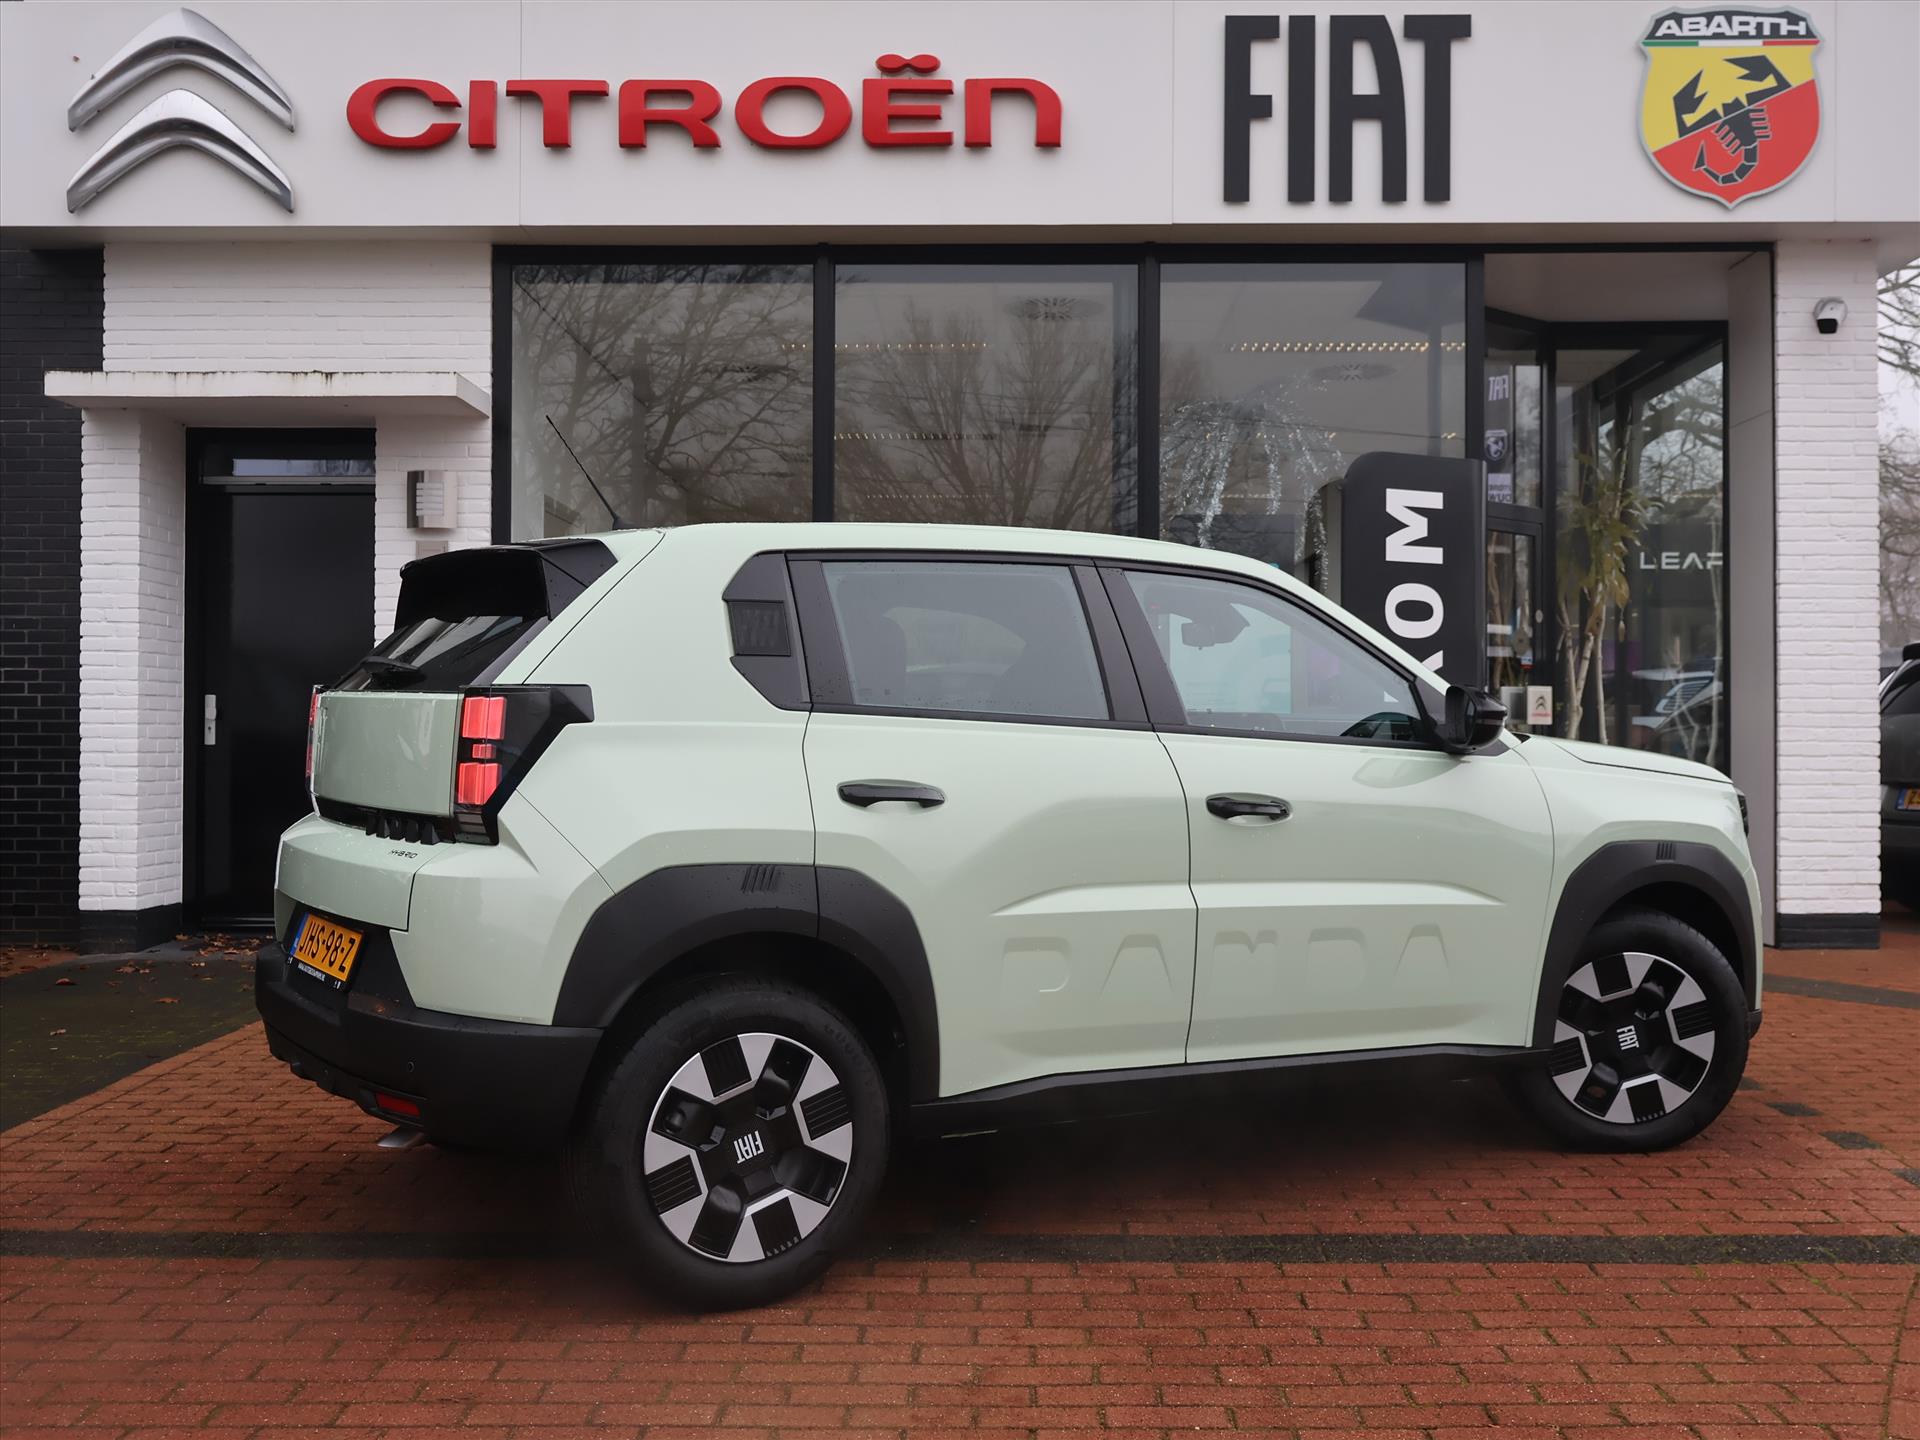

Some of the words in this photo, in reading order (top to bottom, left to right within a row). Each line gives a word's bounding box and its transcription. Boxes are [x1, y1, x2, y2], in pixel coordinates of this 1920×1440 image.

[1654, 14, 1808, 38] ABARTH
[1224, 14, 1471, 204] FIAT
[1384, 487, 1444, 673] OM
[298, 919, 356, 974] JHS-98-Z
[1616, 1025, 1640, 1050] FIAT
[733, 1130, 765, 1164] FIAT
